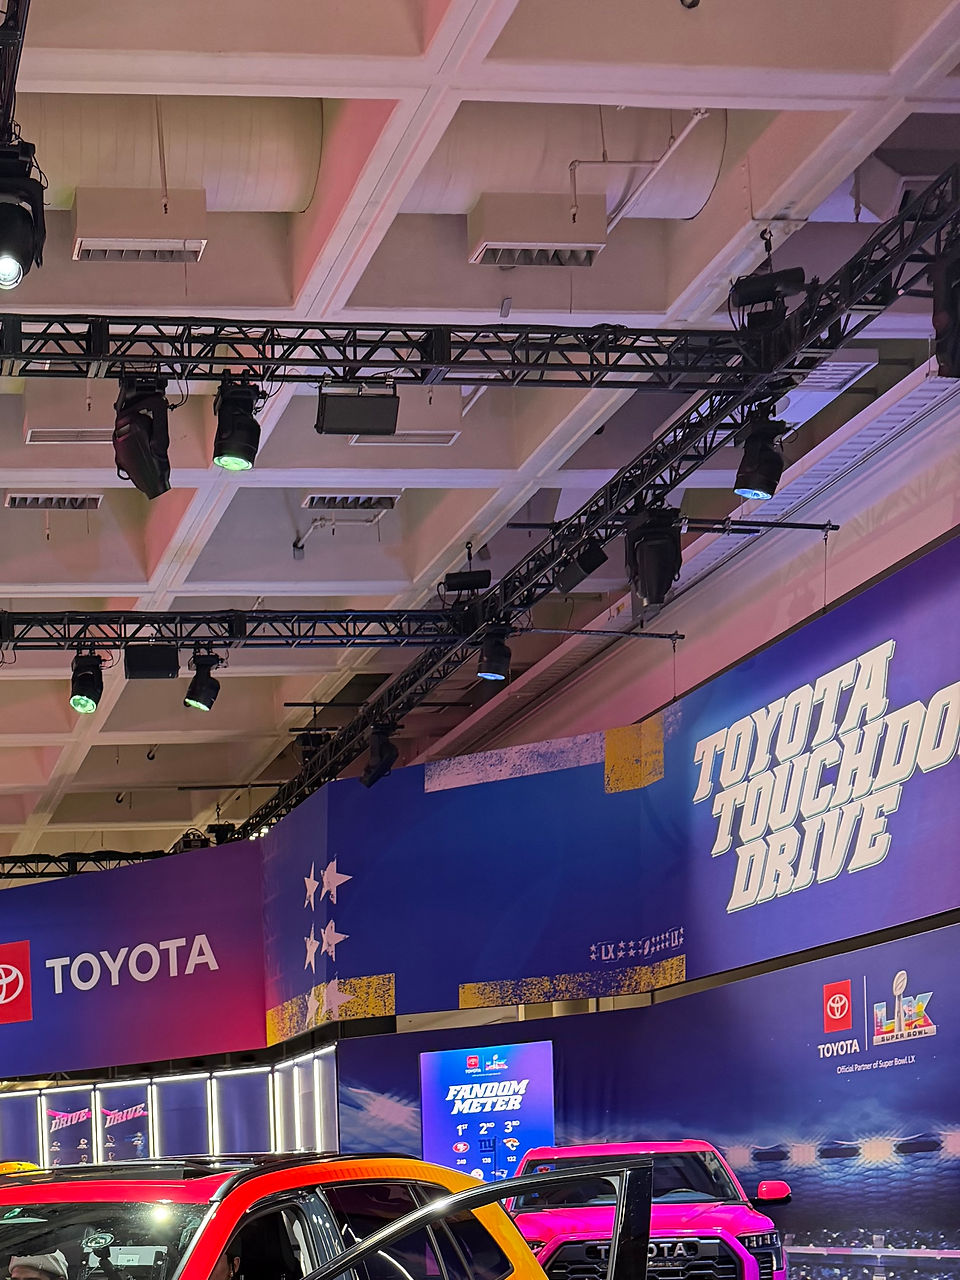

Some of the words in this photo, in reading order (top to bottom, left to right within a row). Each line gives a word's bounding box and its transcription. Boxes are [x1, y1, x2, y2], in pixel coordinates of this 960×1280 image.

[693, 638, 896, 805] TOYOTA
[710, 681, 960, 858] TOUCHDO
[727, 784, 903, 914] DRIVE
[601, 944, 615, 960] LX
[45, 934, 220, 995] TOYOTA
[881, 1032, 905, 1042] SUPER
[907, 1029, 929, 1037] BOWL
[817, 1039, 860, 1058] TOYOTA
[837, 1064, 854, 1074] Official
[855, 1062, 872, 1072] Partner
[879, 1059, 894, 1068] Super
[895, 1056, 908, 1065] Bowl
[908, 1055, 916, 1063] LX
[445, 1079, 530, 1101] FANDOM
[105, 1103, 146, 1128] DRIVE
[451, 1095, 523, 1115] METER
[50, 1108, 89, 1133] DRIVE
[597, 1242, 687, 1259] TOTA
